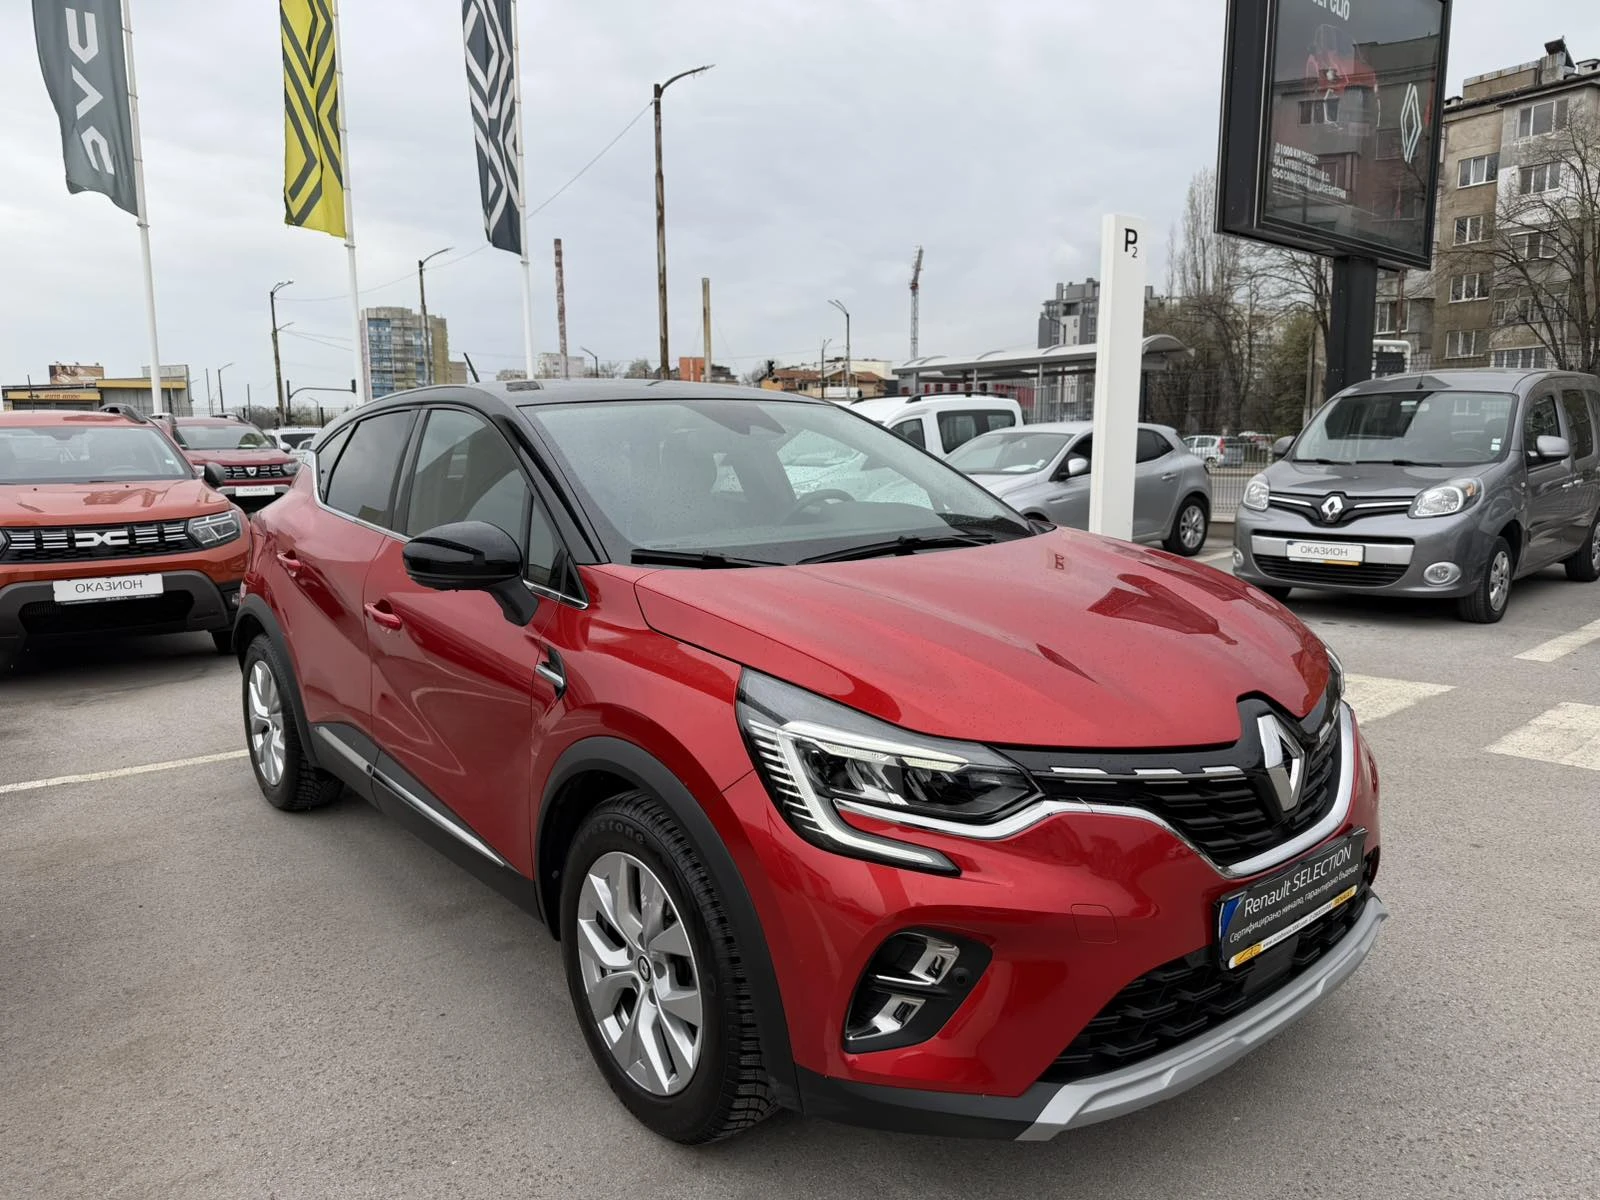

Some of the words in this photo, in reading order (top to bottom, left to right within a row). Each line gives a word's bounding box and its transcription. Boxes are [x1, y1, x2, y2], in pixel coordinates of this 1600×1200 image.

[1330, 0, 1350, 21] CLIO
[1300, 545, 1348, 557] ОКАЗИОН
[75, 579, 143, 594] ОКАЗИОН
[1244, 879, 1291, 918] Renault
[1292, 843, 1352, 892] SELECTION
[1229, 909, 1282, 944] Сертифицирано
